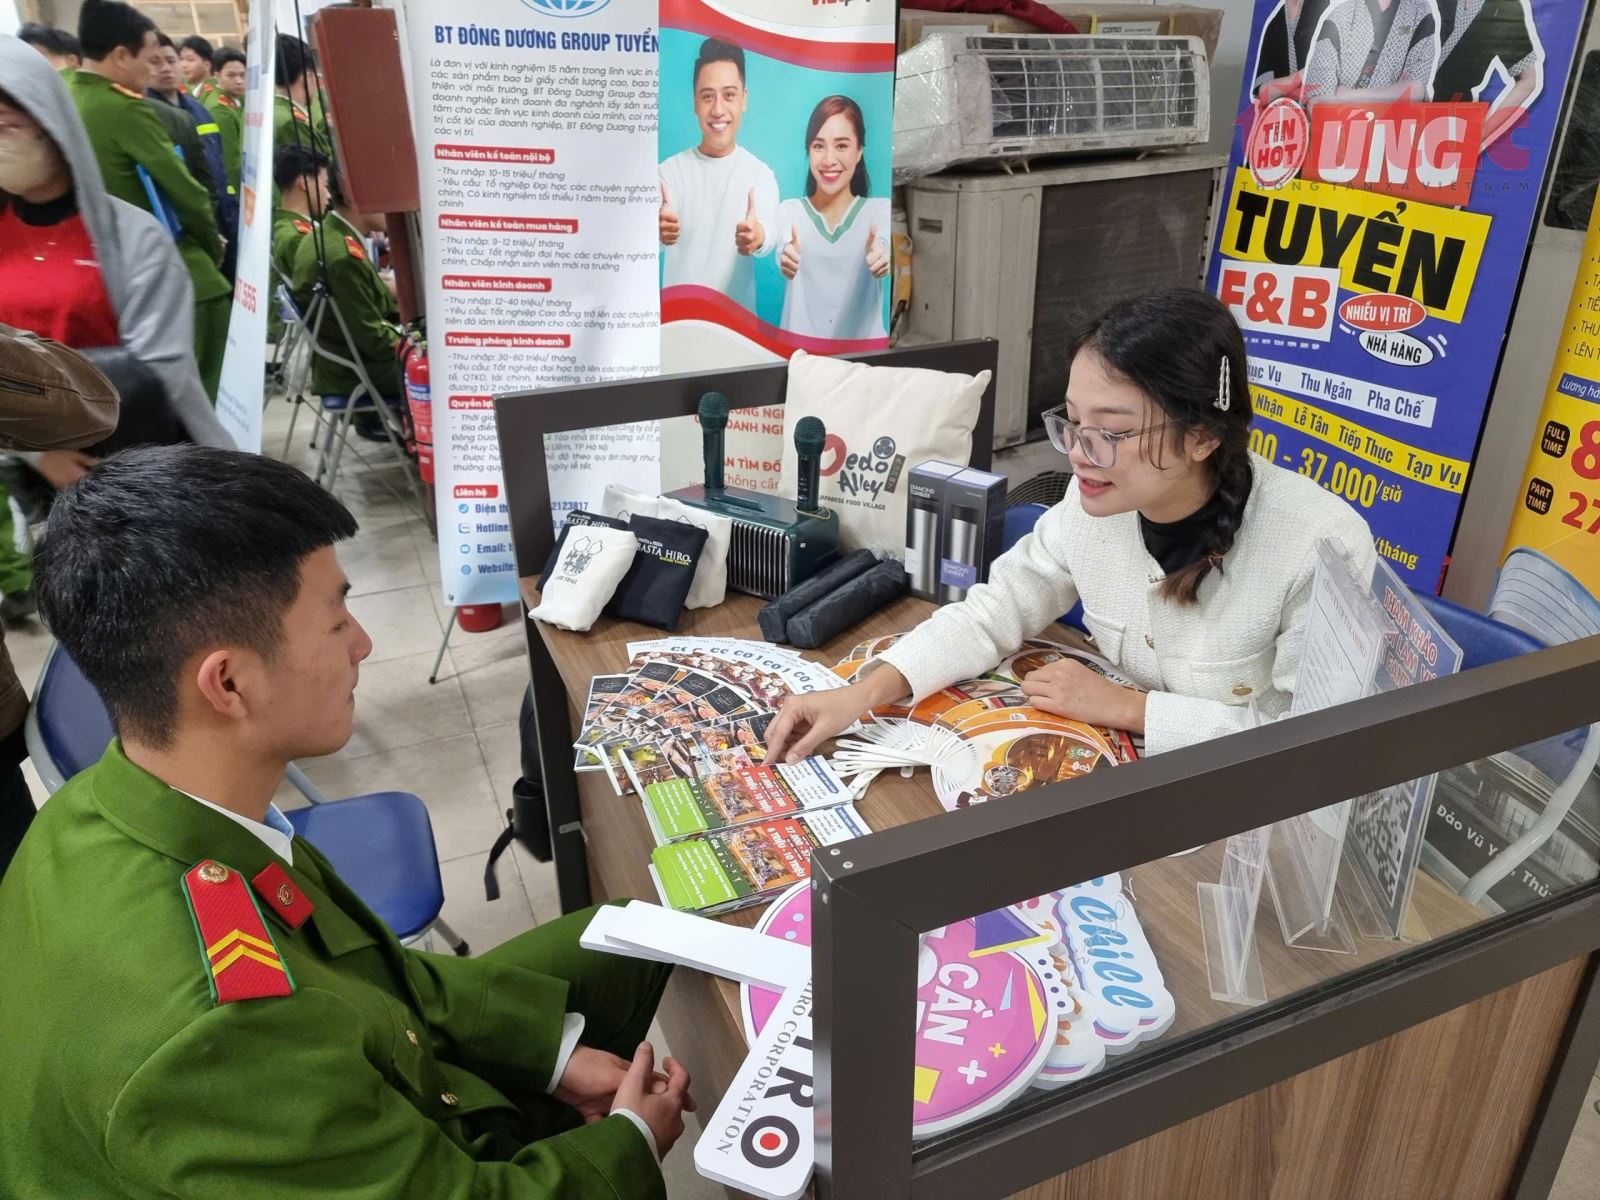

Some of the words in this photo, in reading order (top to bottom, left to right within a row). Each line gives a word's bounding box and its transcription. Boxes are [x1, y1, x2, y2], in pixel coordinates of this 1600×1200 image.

[435, 25, 453, 44] BT
[458, 23, 500, 46] ĐÔNG
[505, 28, 556, 50] DƯƠNG
[561, 32, 611, 51] GROUP
[1263, 118, 1295, 143] TIN
[1257, 143, 1297, 168] HOT
[1317, 111, 1468, 188] ỨNG
[1235, 190, 1466, 311] TUYỂN
[1346, 303, 1377, 322] NHIỀU
[1379, 305, 1391, 325] VỊ
[1393, 303, 1412, 323] TRÍ
[1366, 332, 1388, 355] NHÀ
[1390, 338, 1423, 364] HÀNG
[1574, 341, 1594, 360] LÊN
[1269, 365, 1282, 386] Vụ
[1301, 372, 1321, 392] Thu
[1324, 377, 1352, 401] Ngân
[1367, 390, 1390, 412] Pha
[1394, 397, 1425, 419] Chế
[726, 420, 758, 432] OANH
[1547, 425, 1566, 442] FULL
[1255, 393, 1283, 418] Nhận
[1294, 406, 1306, 426] Lễ
[1309, 411, 1329, 436] Tân
[1339, 425, 1361, 451] Tiếp
[1365, 436, 1394, 465] Thực
[1406, 453, 1433, 480] Tạp
[1439, 463, 1463, 489] Vụ
[1543, 438, 1563, 455] TIME
[724, 474, 757, 490] hông
[837, 470, 886, 502] Alley
[1531, 482, 1551, 499] PART
[475, 503, 497, 516] Điện
[1528, 495, 1547, 512] TIME
[477, 543, 506, 554] Email:
[1384, 585, 1409, 633] THAM
[1409, 619, 1438, 667] KHẢO
[1436, 804, 1463, 830] Đảo
[1467, 827, 1484, 848] Vũ
[1522, 870, 1552, 898] Thủ
[792, 980, 812, 1016] IRO
[715, 1020, 797, 1155] CORPORATION
